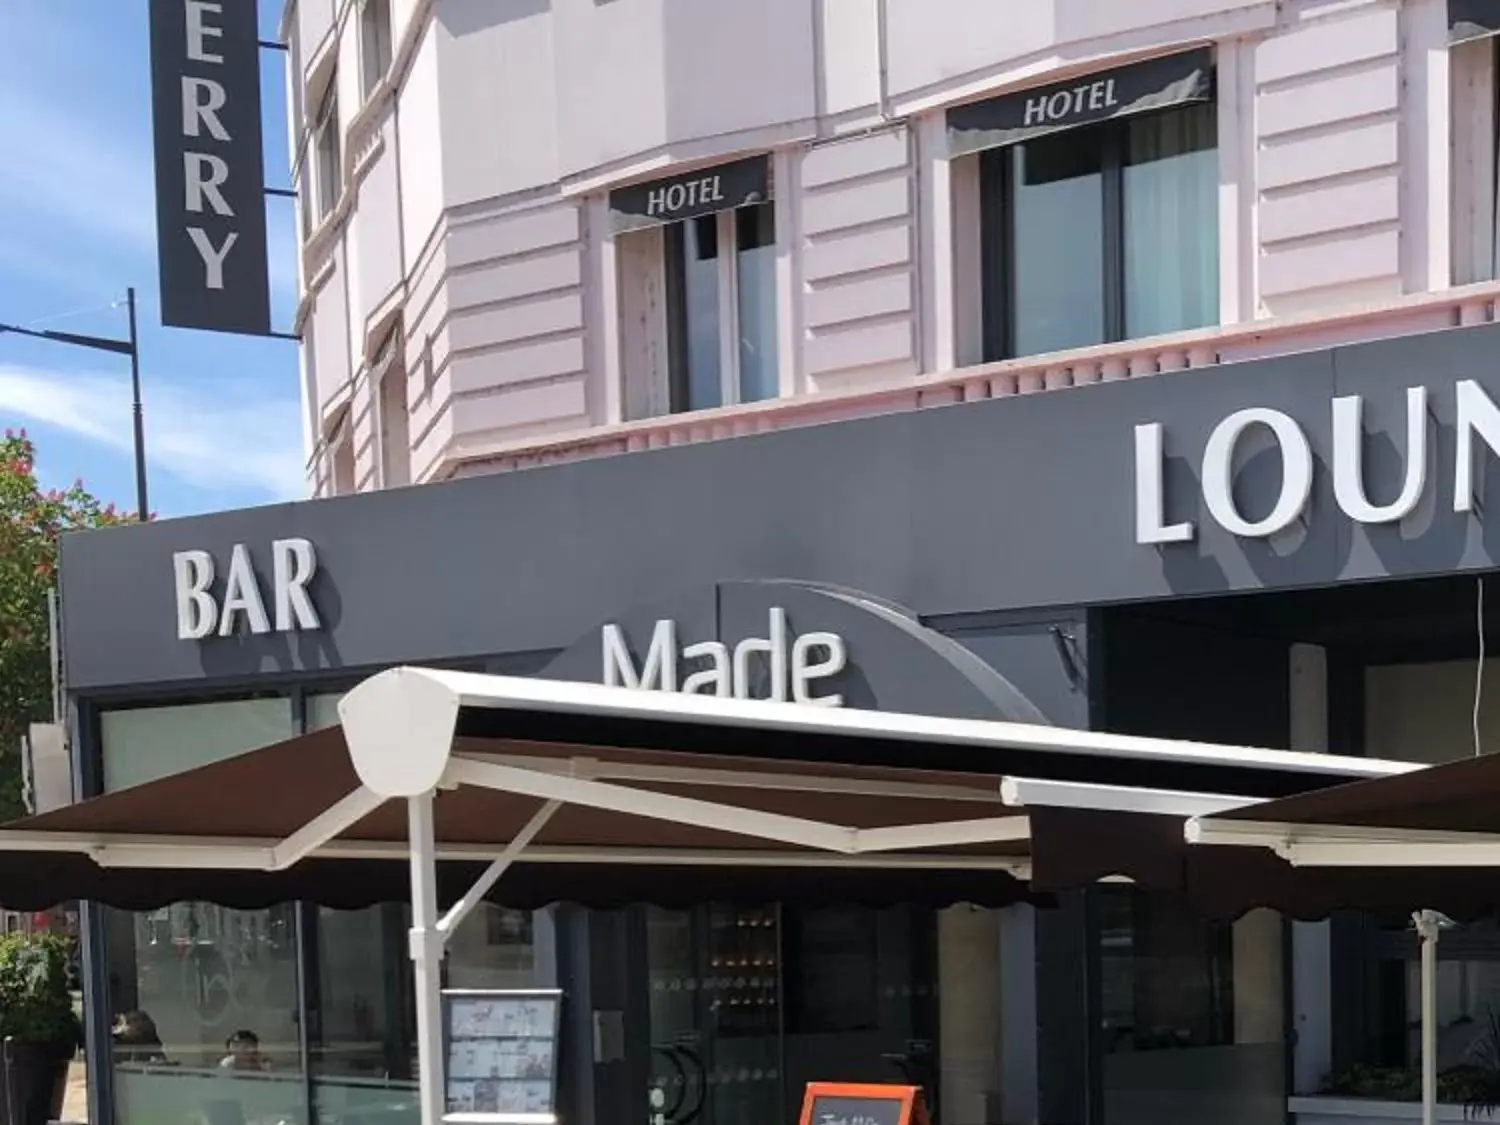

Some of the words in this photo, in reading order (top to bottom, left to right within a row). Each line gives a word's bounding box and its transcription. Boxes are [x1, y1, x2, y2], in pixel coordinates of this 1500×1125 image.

[181, 0, 239, 289] ERRY
[1024, 79, 1117, 126] HOTEL
[647, 175, 724, 216] HOTEL
[173, 537, 320, 640] BAR
[602, 606, 846, 706] Made
